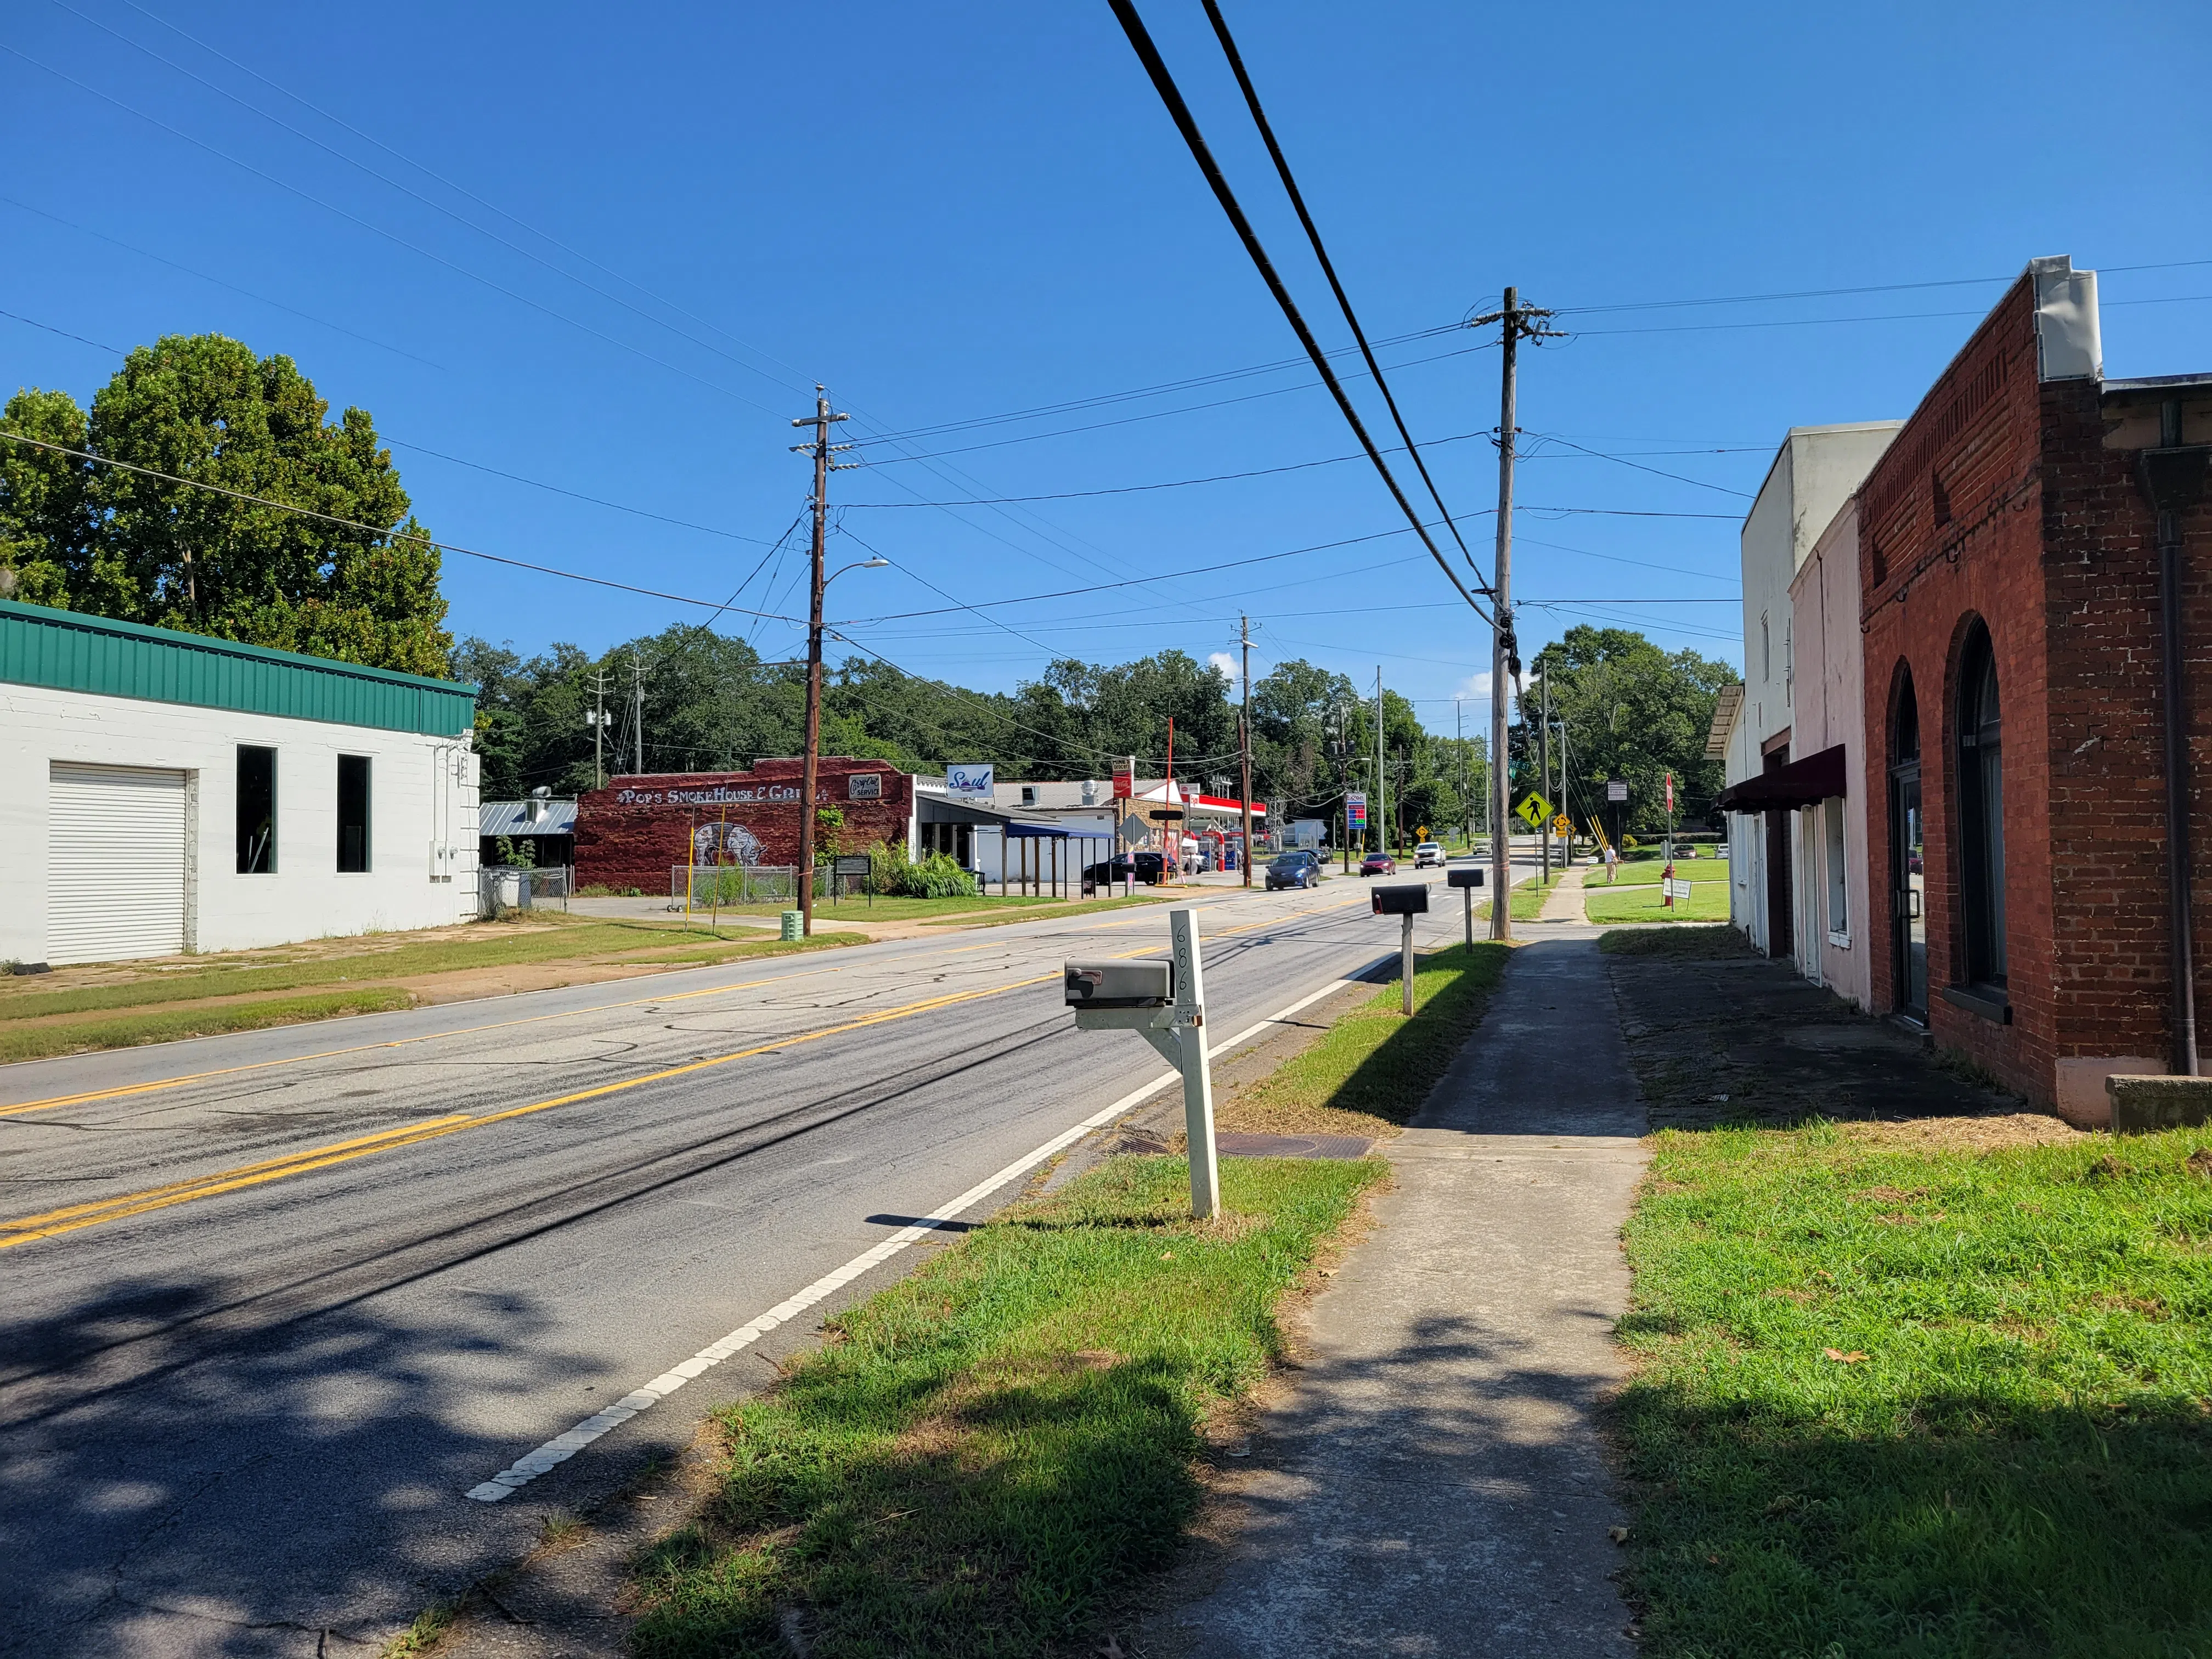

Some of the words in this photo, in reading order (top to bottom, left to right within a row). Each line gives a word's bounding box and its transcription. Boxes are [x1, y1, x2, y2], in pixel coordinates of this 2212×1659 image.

[1508, 760, 1520, 768] ORE
[850, 777, 879, 795] Carry-Out
[1177, 924, 1187, 990] 686
